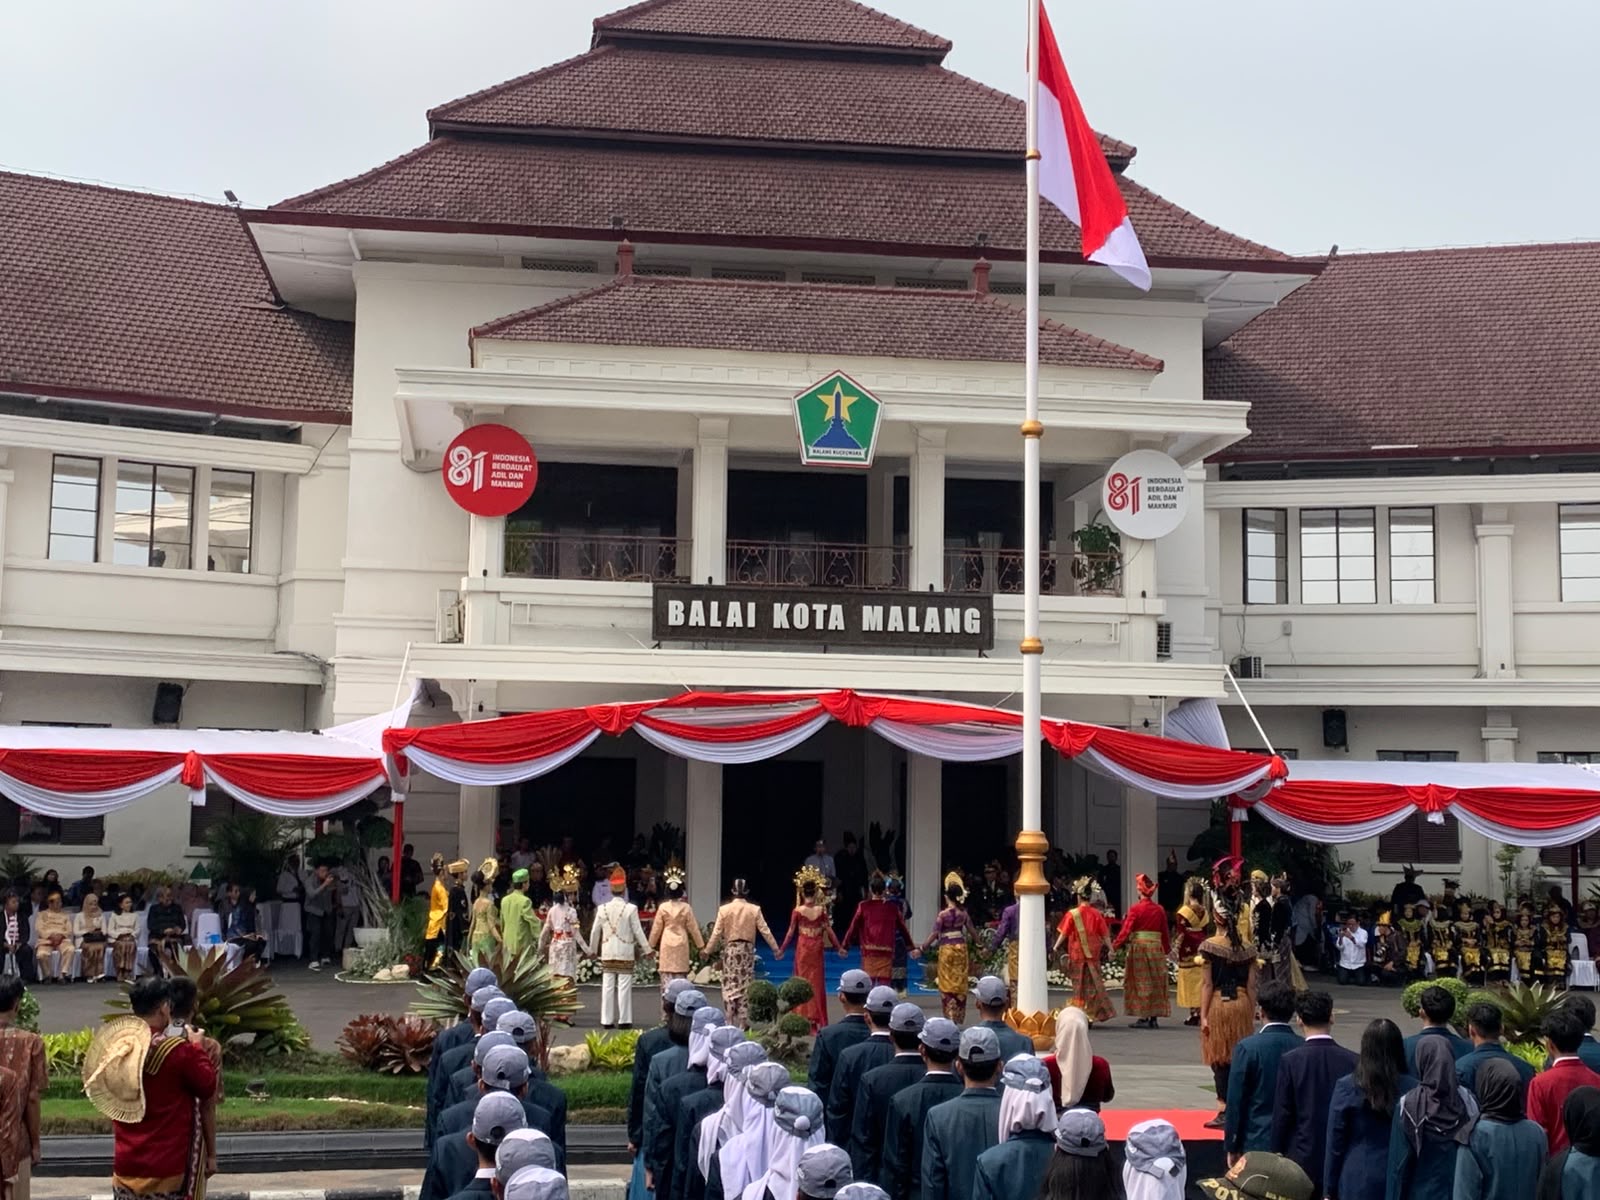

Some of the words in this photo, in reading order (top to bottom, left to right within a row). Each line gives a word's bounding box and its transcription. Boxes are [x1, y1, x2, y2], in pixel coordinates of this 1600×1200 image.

[492, 454, 530, 463] INDONESIA
[448, 445, 489, 493] 81
[491, 462, 533, 472] BERDAULAT
[491, 471, 507, 479] ADIL
[508, 472, 524, 480] DAN
[490, 480, 524, 489] MAKMUR
[1108, 472, 1143, 516] 81
[667, 599, 757, 629] BALAI
[772, 601, 846, 631] KOTA
[861, 604, 982, 635] MALANG
